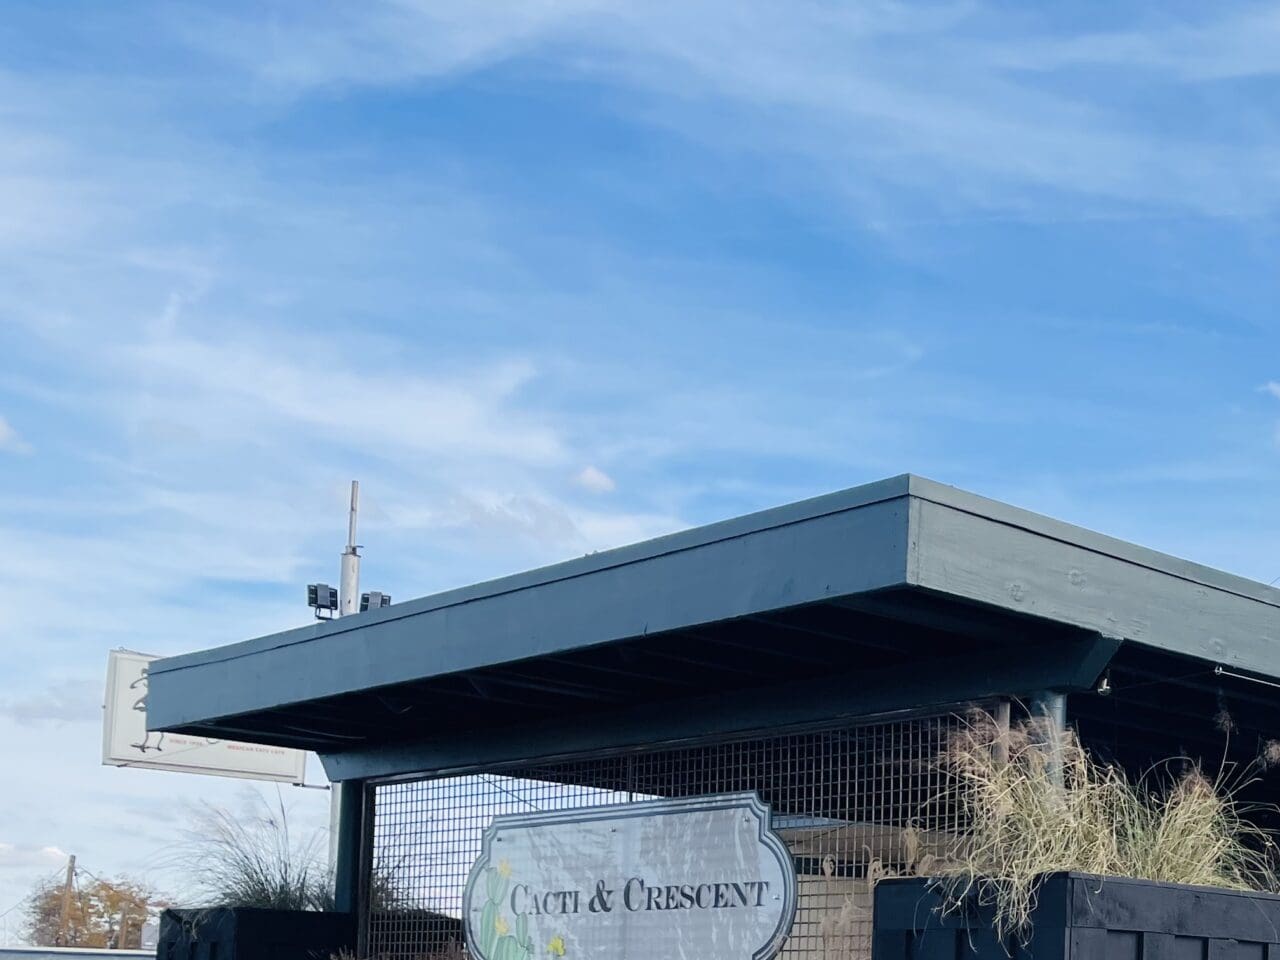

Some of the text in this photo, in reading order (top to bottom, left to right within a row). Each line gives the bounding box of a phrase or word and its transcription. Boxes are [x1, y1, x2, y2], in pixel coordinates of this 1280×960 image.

[510, 877, 769, 916] CACTI & CRESCENT
